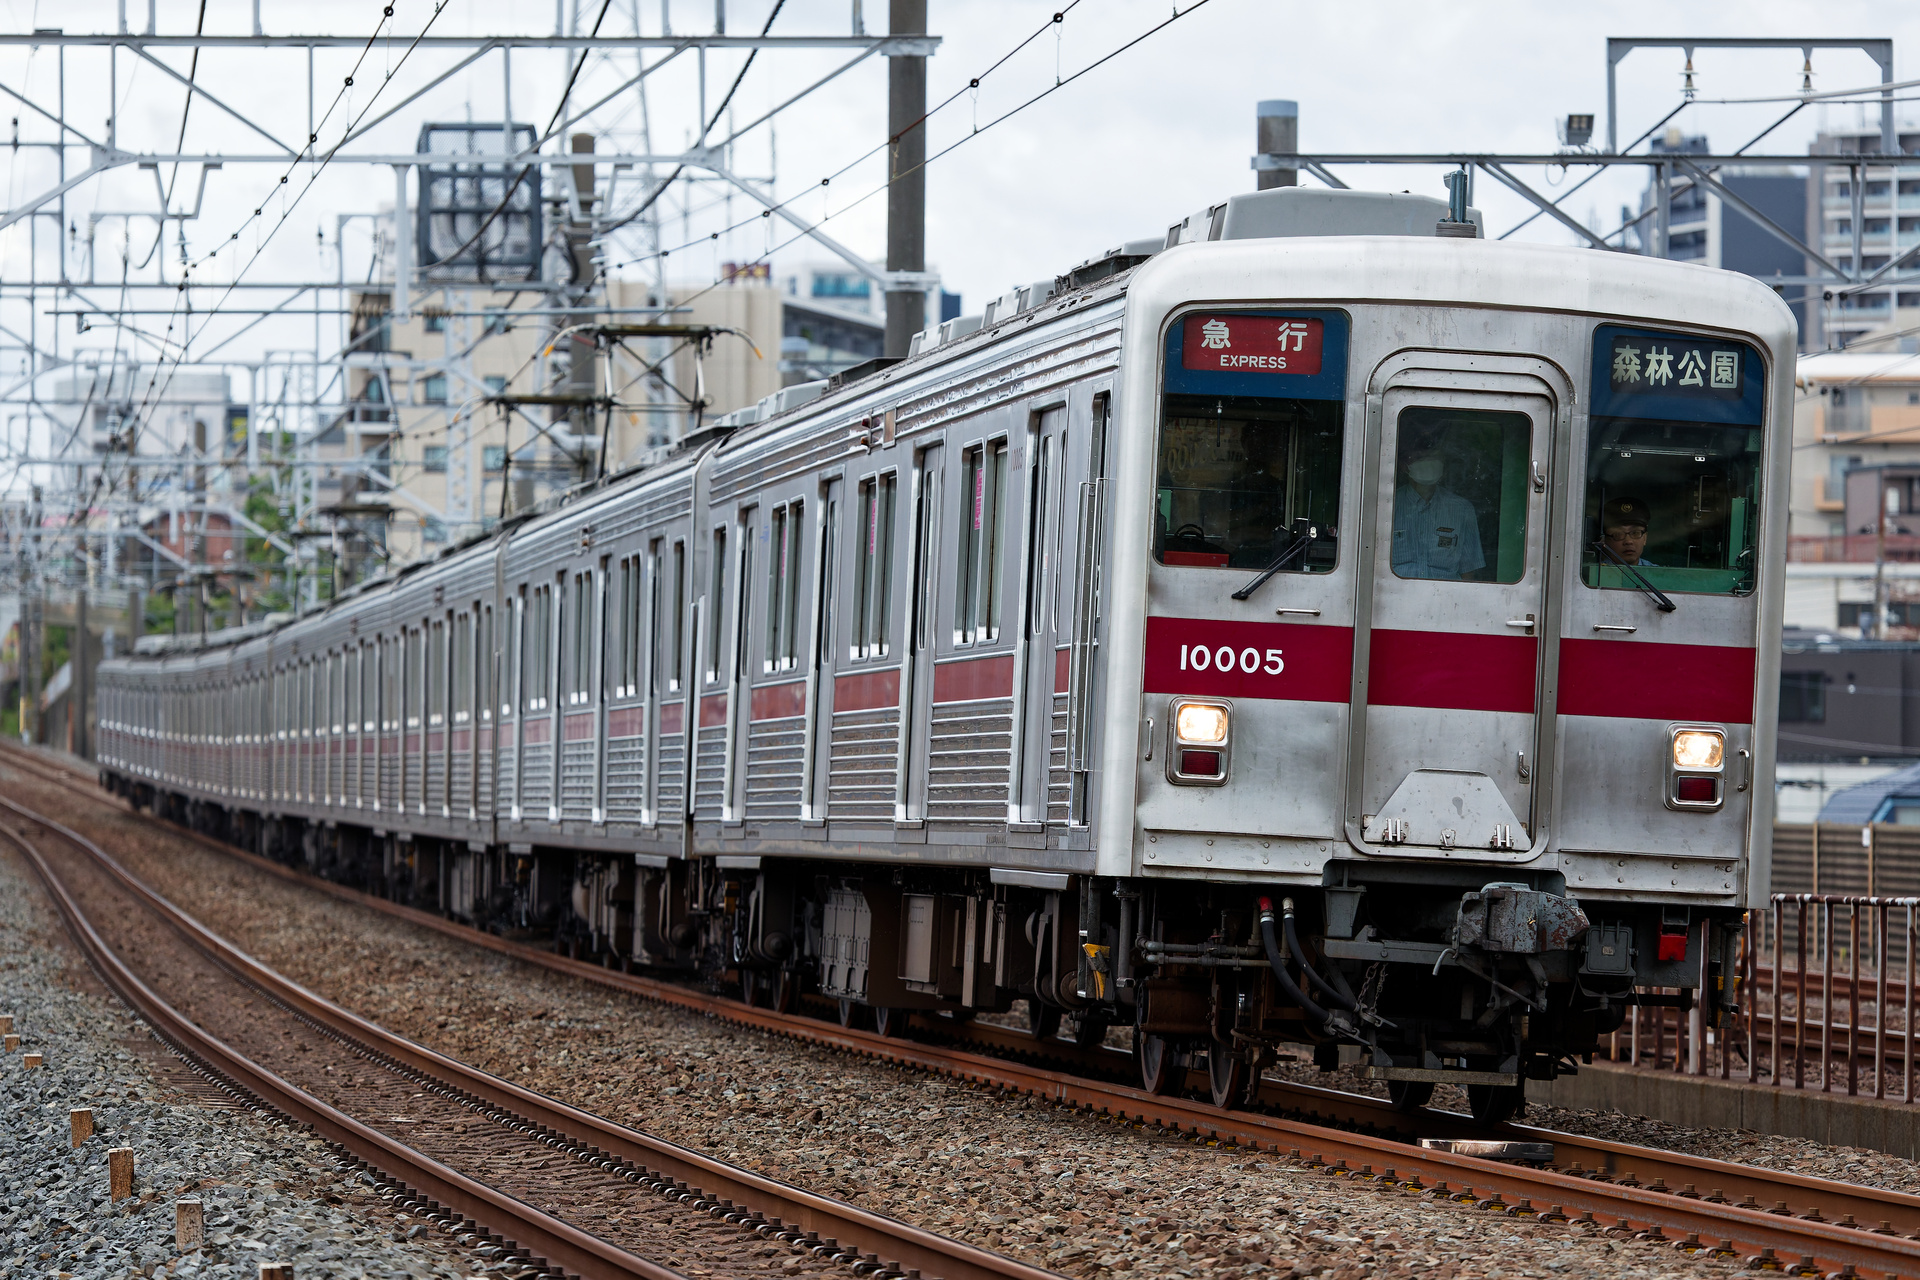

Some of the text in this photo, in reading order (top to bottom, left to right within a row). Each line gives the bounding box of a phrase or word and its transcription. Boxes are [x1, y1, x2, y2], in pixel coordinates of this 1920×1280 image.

[1200, 318, 1308, 353] 急行
[1219, 354, 1287, 370] EXPRESS
[1612, 344, 1739, 389] 森林公園
[1179, 644, 1285, 676] 10005
